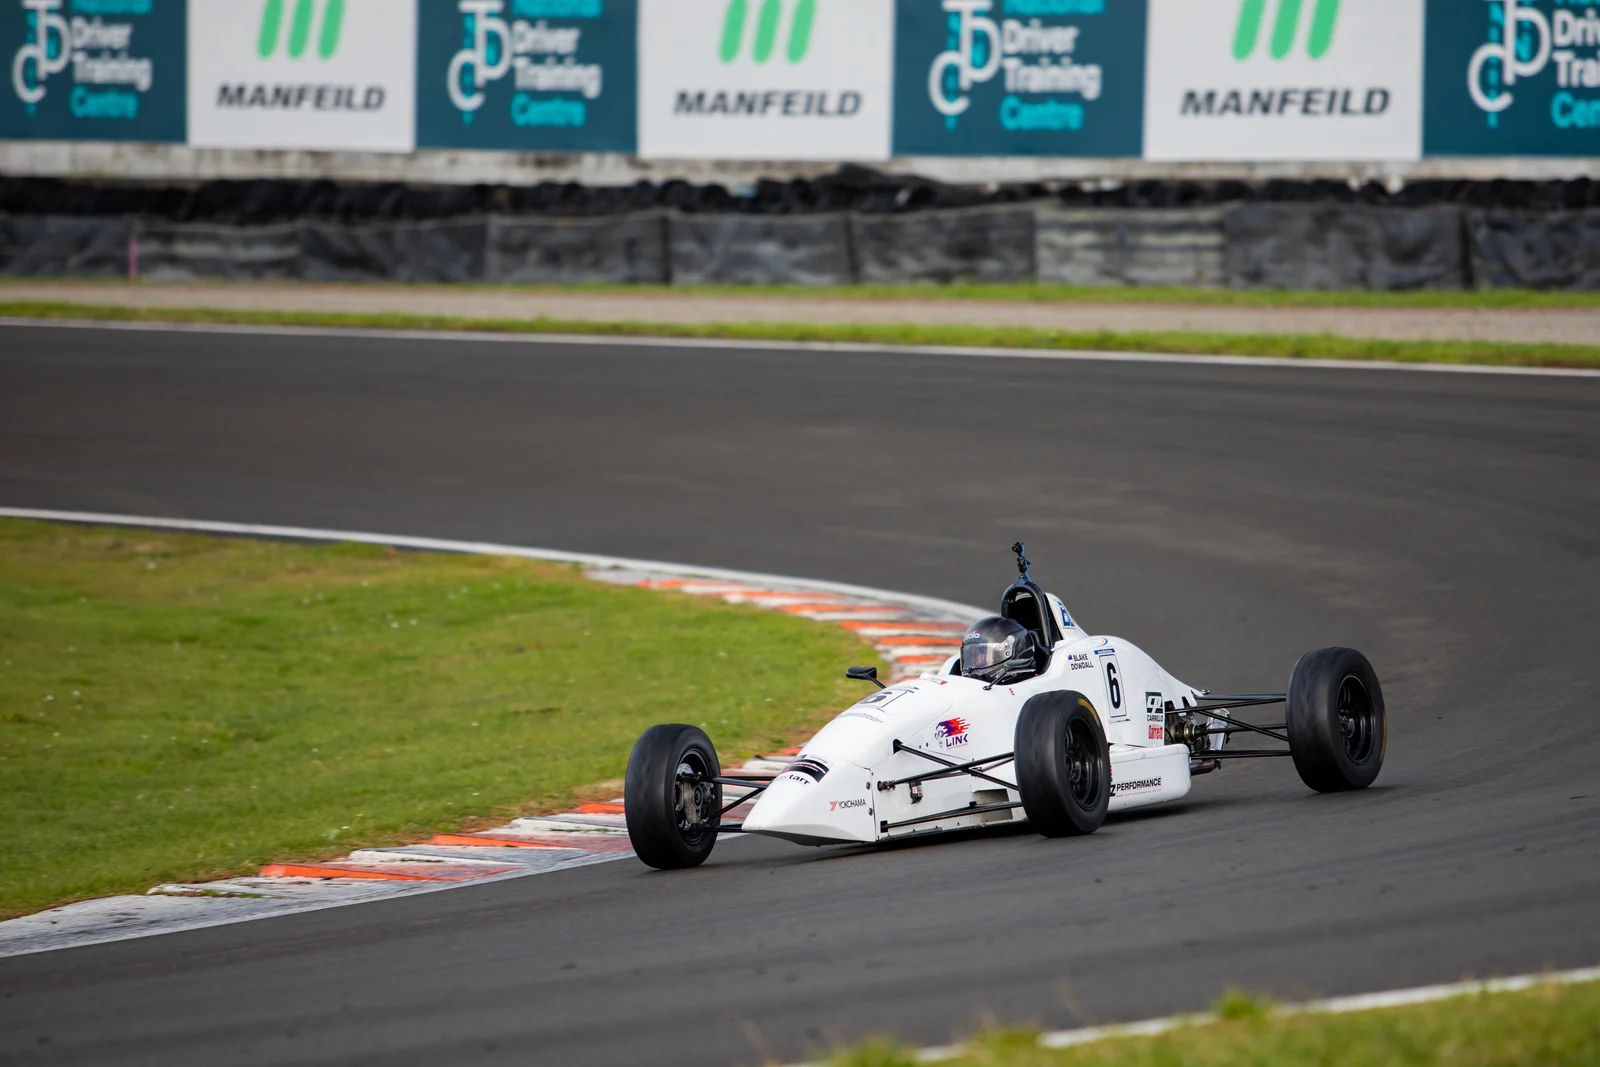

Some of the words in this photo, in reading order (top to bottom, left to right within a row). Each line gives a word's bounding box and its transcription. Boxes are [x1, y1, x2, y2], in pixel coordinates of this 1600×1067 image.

[70, 15, 133, 49] Driver
[512, 19, 582, 55] Driver
[1001, 18, 1080, 54] Driver
[71, 51, 153, 91] Training
[512, 56, 603, 98] Training
[1001, 57, 1102, 100] Training
[215, 82, 386, 112] MANFEILD
[673, 89, 862, 118] MANFEILD
[1000, 95, 1085, 131] Centre
[1179, 87, 1392, 118] MANFEILD
[1070, 661, 1094, 671] DOWDALL
[1072, 653, 1089, 662] BLAKE
[1106, 662, 1121, 709] 6
[945, 733, 969, 748] LINK
[1116, 777, 1162, 792] PERFORMANCE
[837, 798, 867, 810] YOKOHAMA
